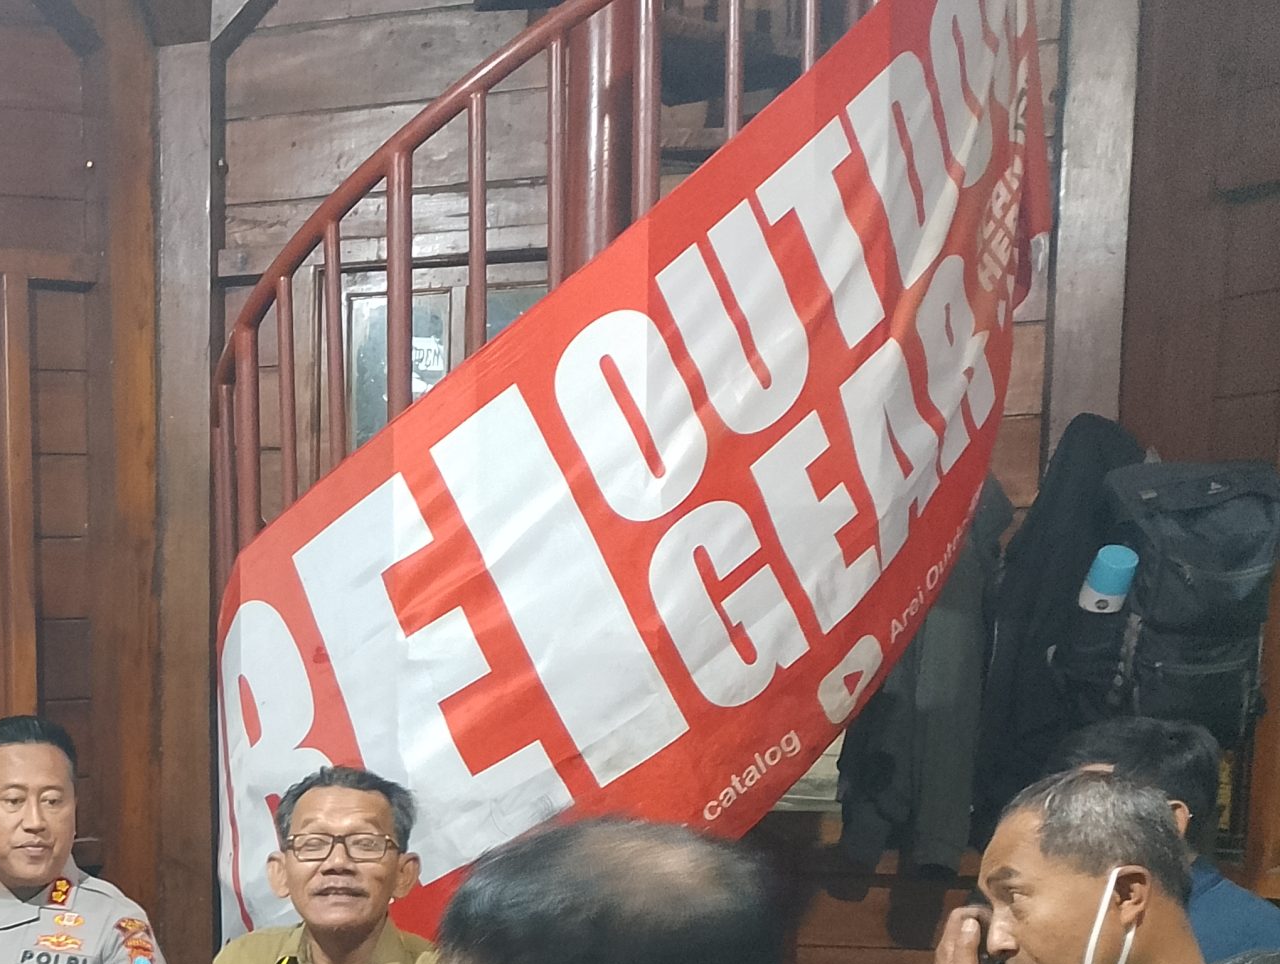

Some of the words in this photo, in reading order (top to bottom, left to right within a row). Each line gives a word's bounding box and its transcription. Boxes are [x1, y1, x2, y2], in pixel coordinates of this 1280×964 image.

[649, 255, 996, 708] GEAR
[889, 587, 924, 643] Arei
[220, 385, 689, 930] REI
[703, 730, 801, 820] catalog
